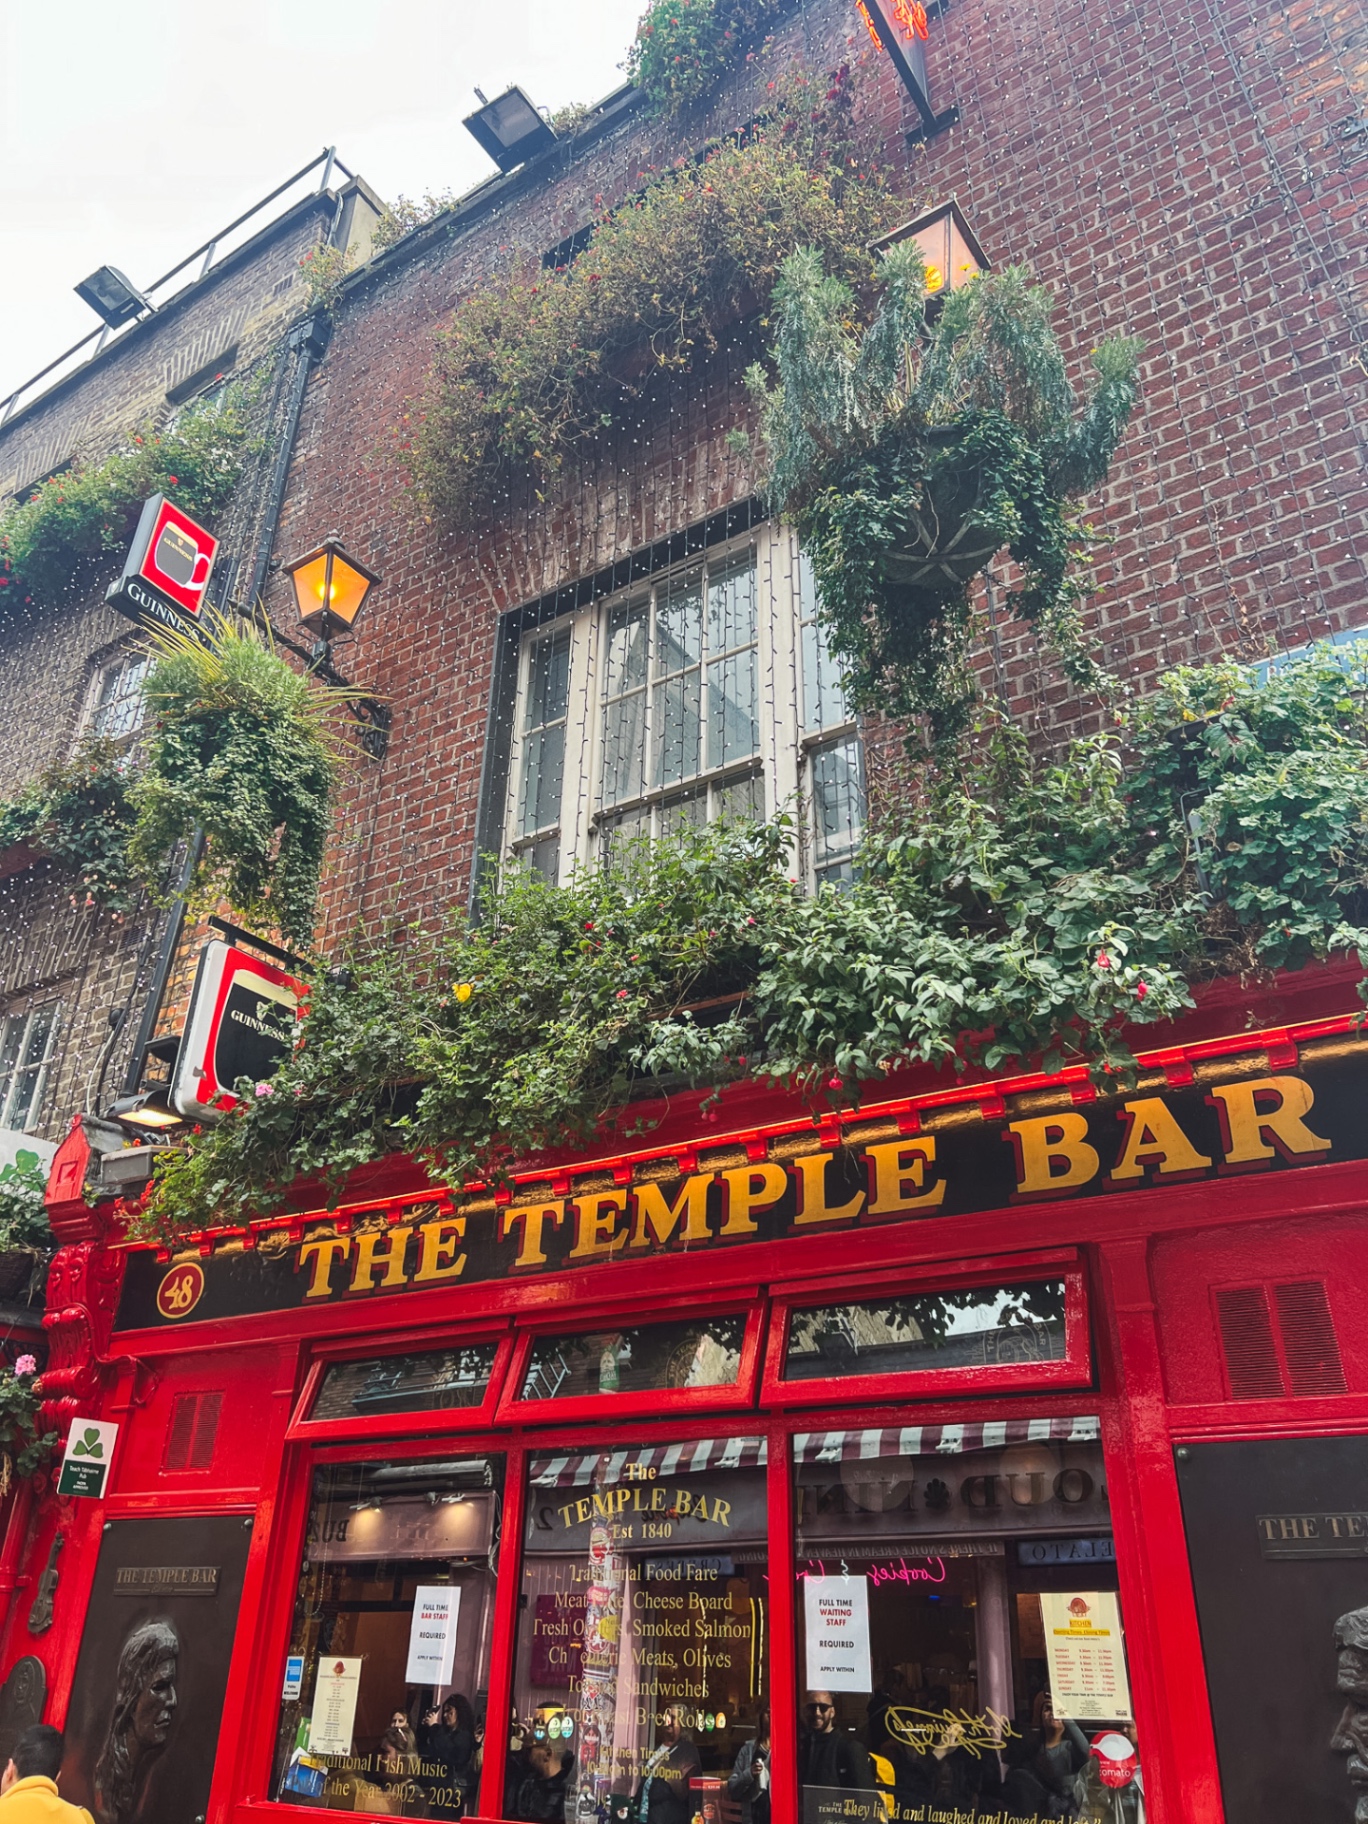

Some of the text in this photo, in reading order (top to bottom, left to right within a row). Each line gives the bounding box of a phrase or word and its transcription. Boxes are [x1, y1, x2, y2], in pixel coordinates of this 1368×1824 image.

[299, 1075, 1332, 1297] THE TEMPLE BAR
[164, 1275, 194, 1309] 48
[625, 1462, 657, 1481] The
[557, 1488, 667, 1529] TEMPLE
[675, 1489, 732, 1527] BAR
[612, 1522, 673, 1539] Est 1840
[1259, 1515, 1368, 1540] THE TE
[117, 1568, 217, 1584] THE TEMPLE BAR
[645, 1564, 683, 1581] Food
[685, 1564, 718, 1581] Fare
[423, 1603, 449, 1611] FULL TIME
[554, 1591, 588, 1608] Meat
[633, 1592, 684, 1609] Cheese
[688, 1592, 733, 1610] Board
[819, 1599, 853, 1607] FULL TIME
[421, 1612, 449, 1620] BAR STAFF
[820, 1609, 852, 1617] WAITING
[826, 1618, 847, 1626] STAFF
[419, 1631, 446, 1640] REQUIRED
[533, 1618, 569, 1636] Fresh
[633, 1619, 690, 1637] Smoked
[694, 1620, 751, 1638] Salmon
[819, 1640, 855, 1649] REQUIRED
[631, 1647, 678, 1668] Meats,
[683, 1648, 732, 1668] Olives
[624, 1677, 710, 1698] Sandwiches
[407, 1757, 448, 1779] Music
[628, 1764, 639, 1776] to
[331, 1778, 350, 1796] the
[354, 1779, 381, 1799] Year
[385, 1781, 416, 1803] 2002
[428, 1786, 462, 1808] 2023
[843, 1799, 870, 1821] They
[873, 1800, 901, 1820] lied
[903, 1805, 925, 1822] and
[928, 1805, 975, 1824] laughed
[978, 1811, 1001, 1824] and
[1004, 1811, 1038, 1824] loved
